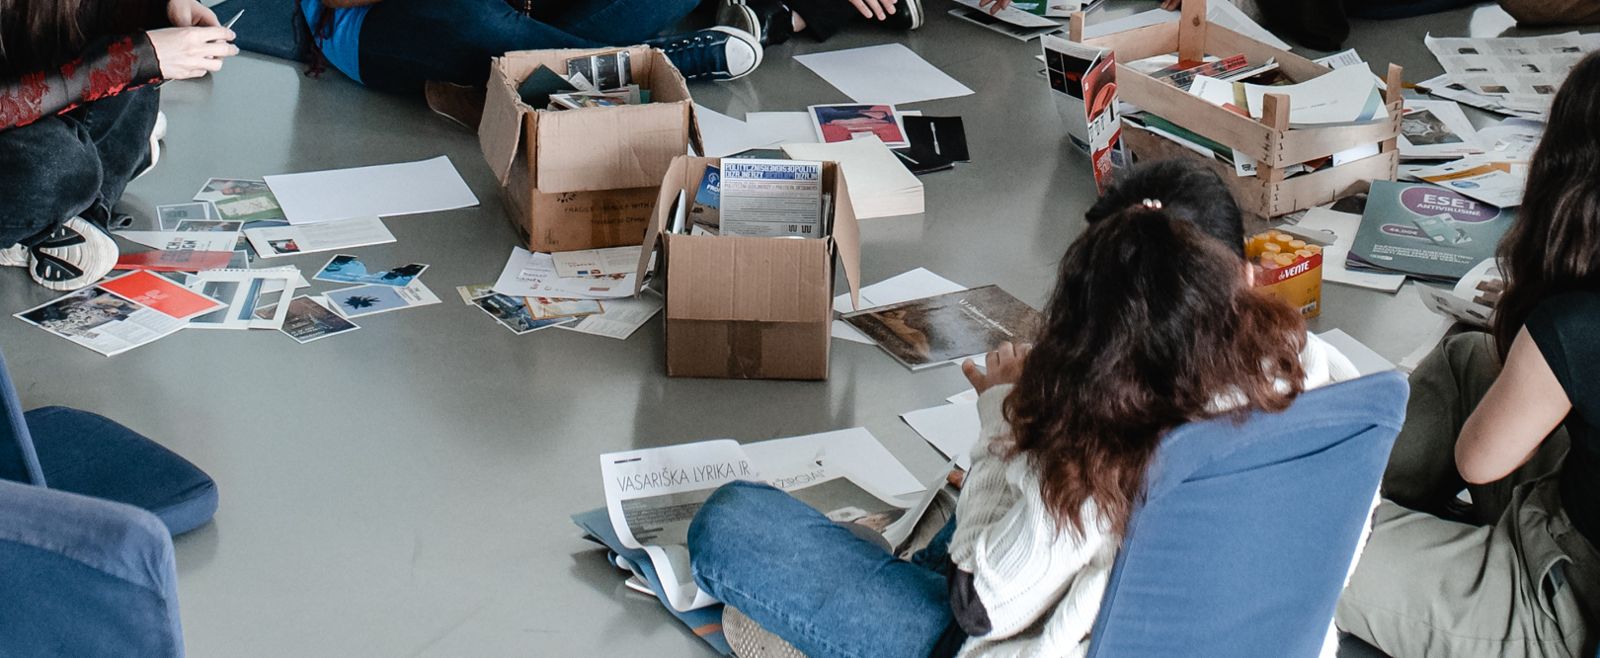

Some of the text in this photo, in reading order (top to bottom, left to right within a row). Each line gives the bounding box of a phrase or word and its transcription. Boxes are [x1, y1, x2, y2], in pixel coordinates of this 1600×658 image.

[1423, 193, 1476, 210] ESET
[616, 460, 751, 493] VASARIŠKA LYRIKA IR
